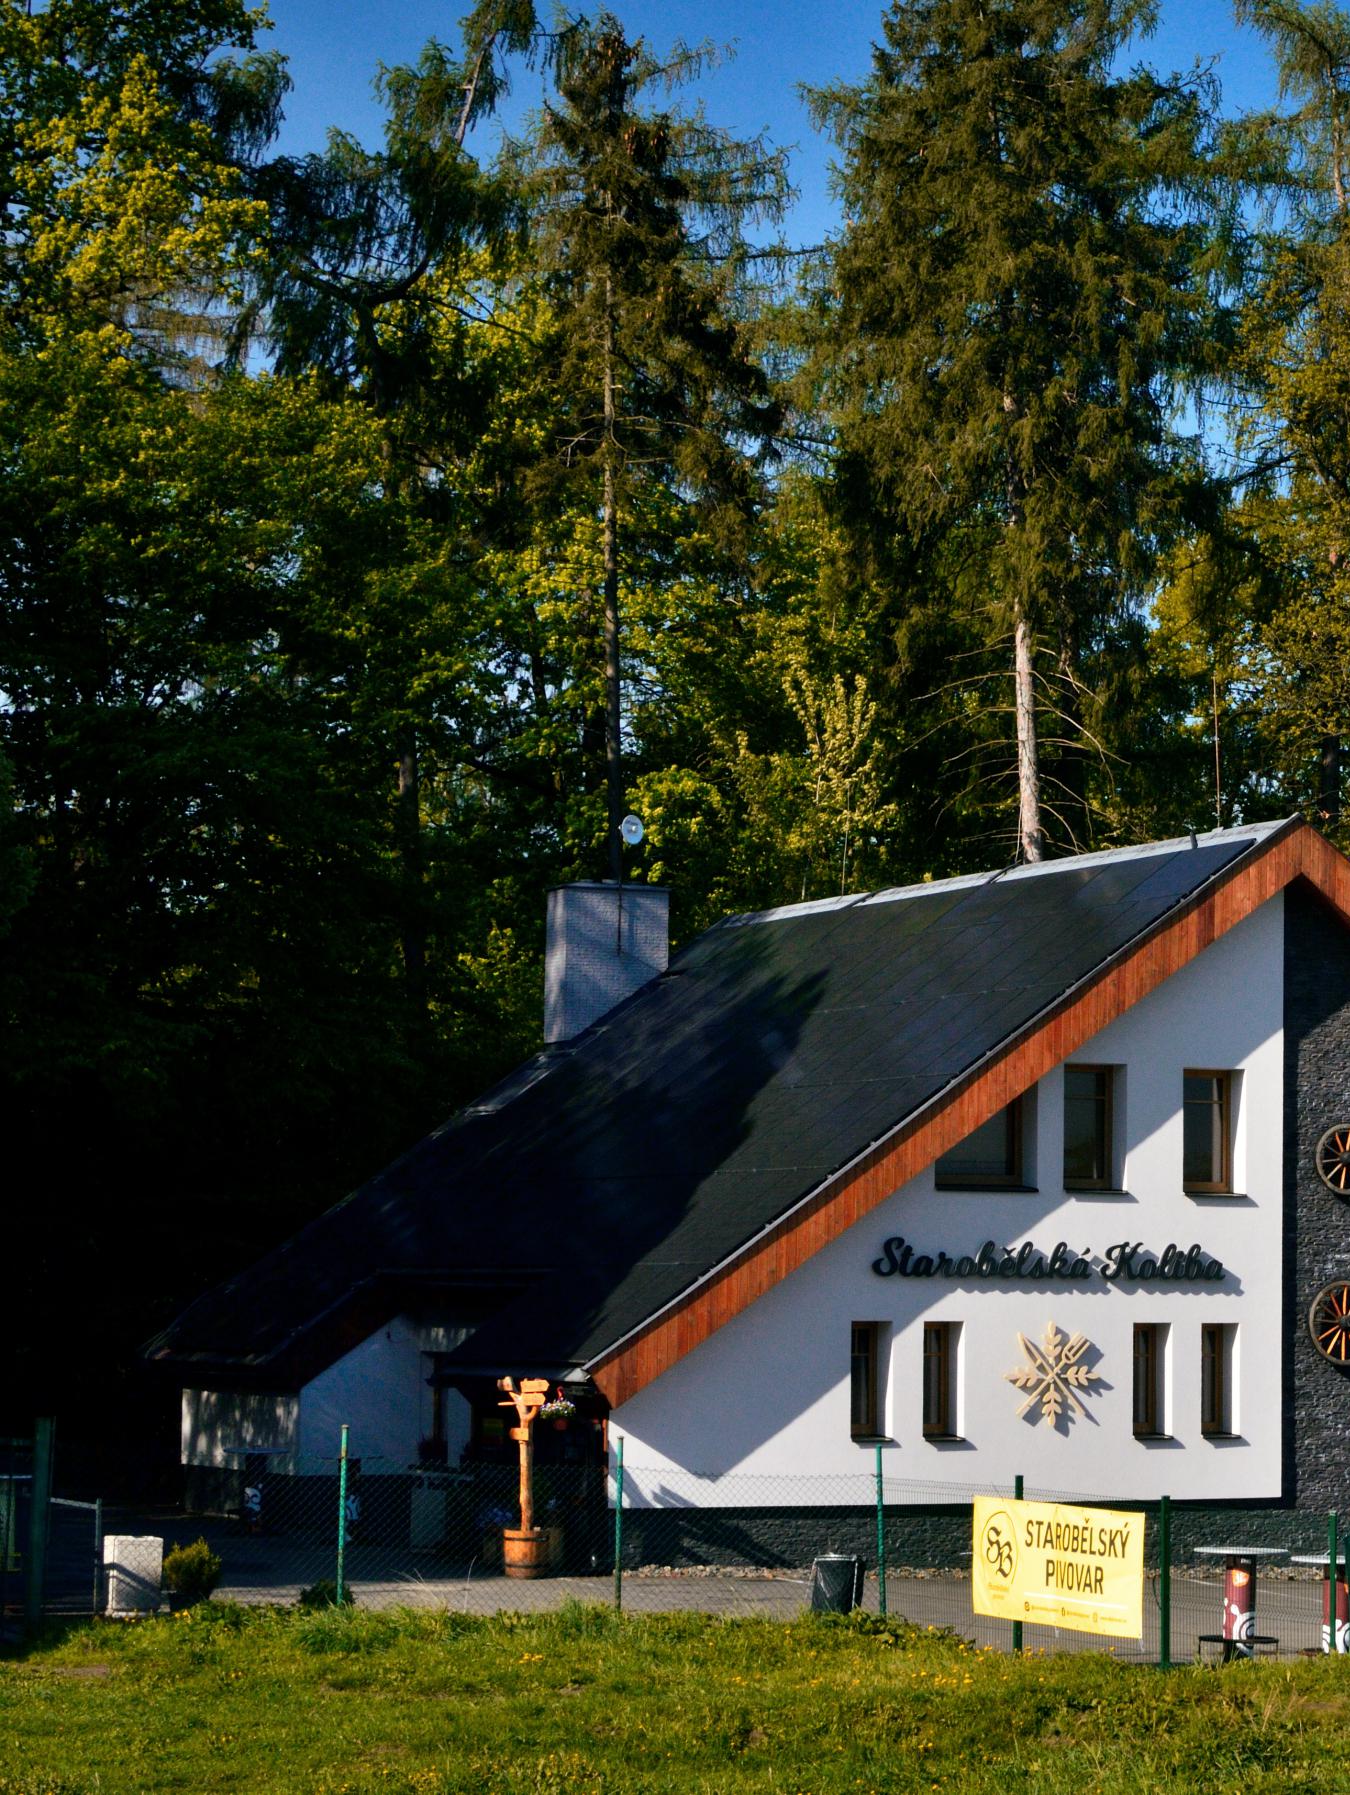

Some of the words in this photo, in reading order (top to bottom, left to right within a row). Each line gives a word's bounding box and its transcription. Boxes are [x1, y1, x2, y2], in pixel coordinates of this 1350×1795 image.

[872, 1236, 1092, 1280] Starobělská
[1100, 1241, 1226, 1281] Koliba
[1025, 1518, 1130, 1559] STAROBĚLSKÝ
[1045, 1560, 1104, 1595] PIVOVAR
